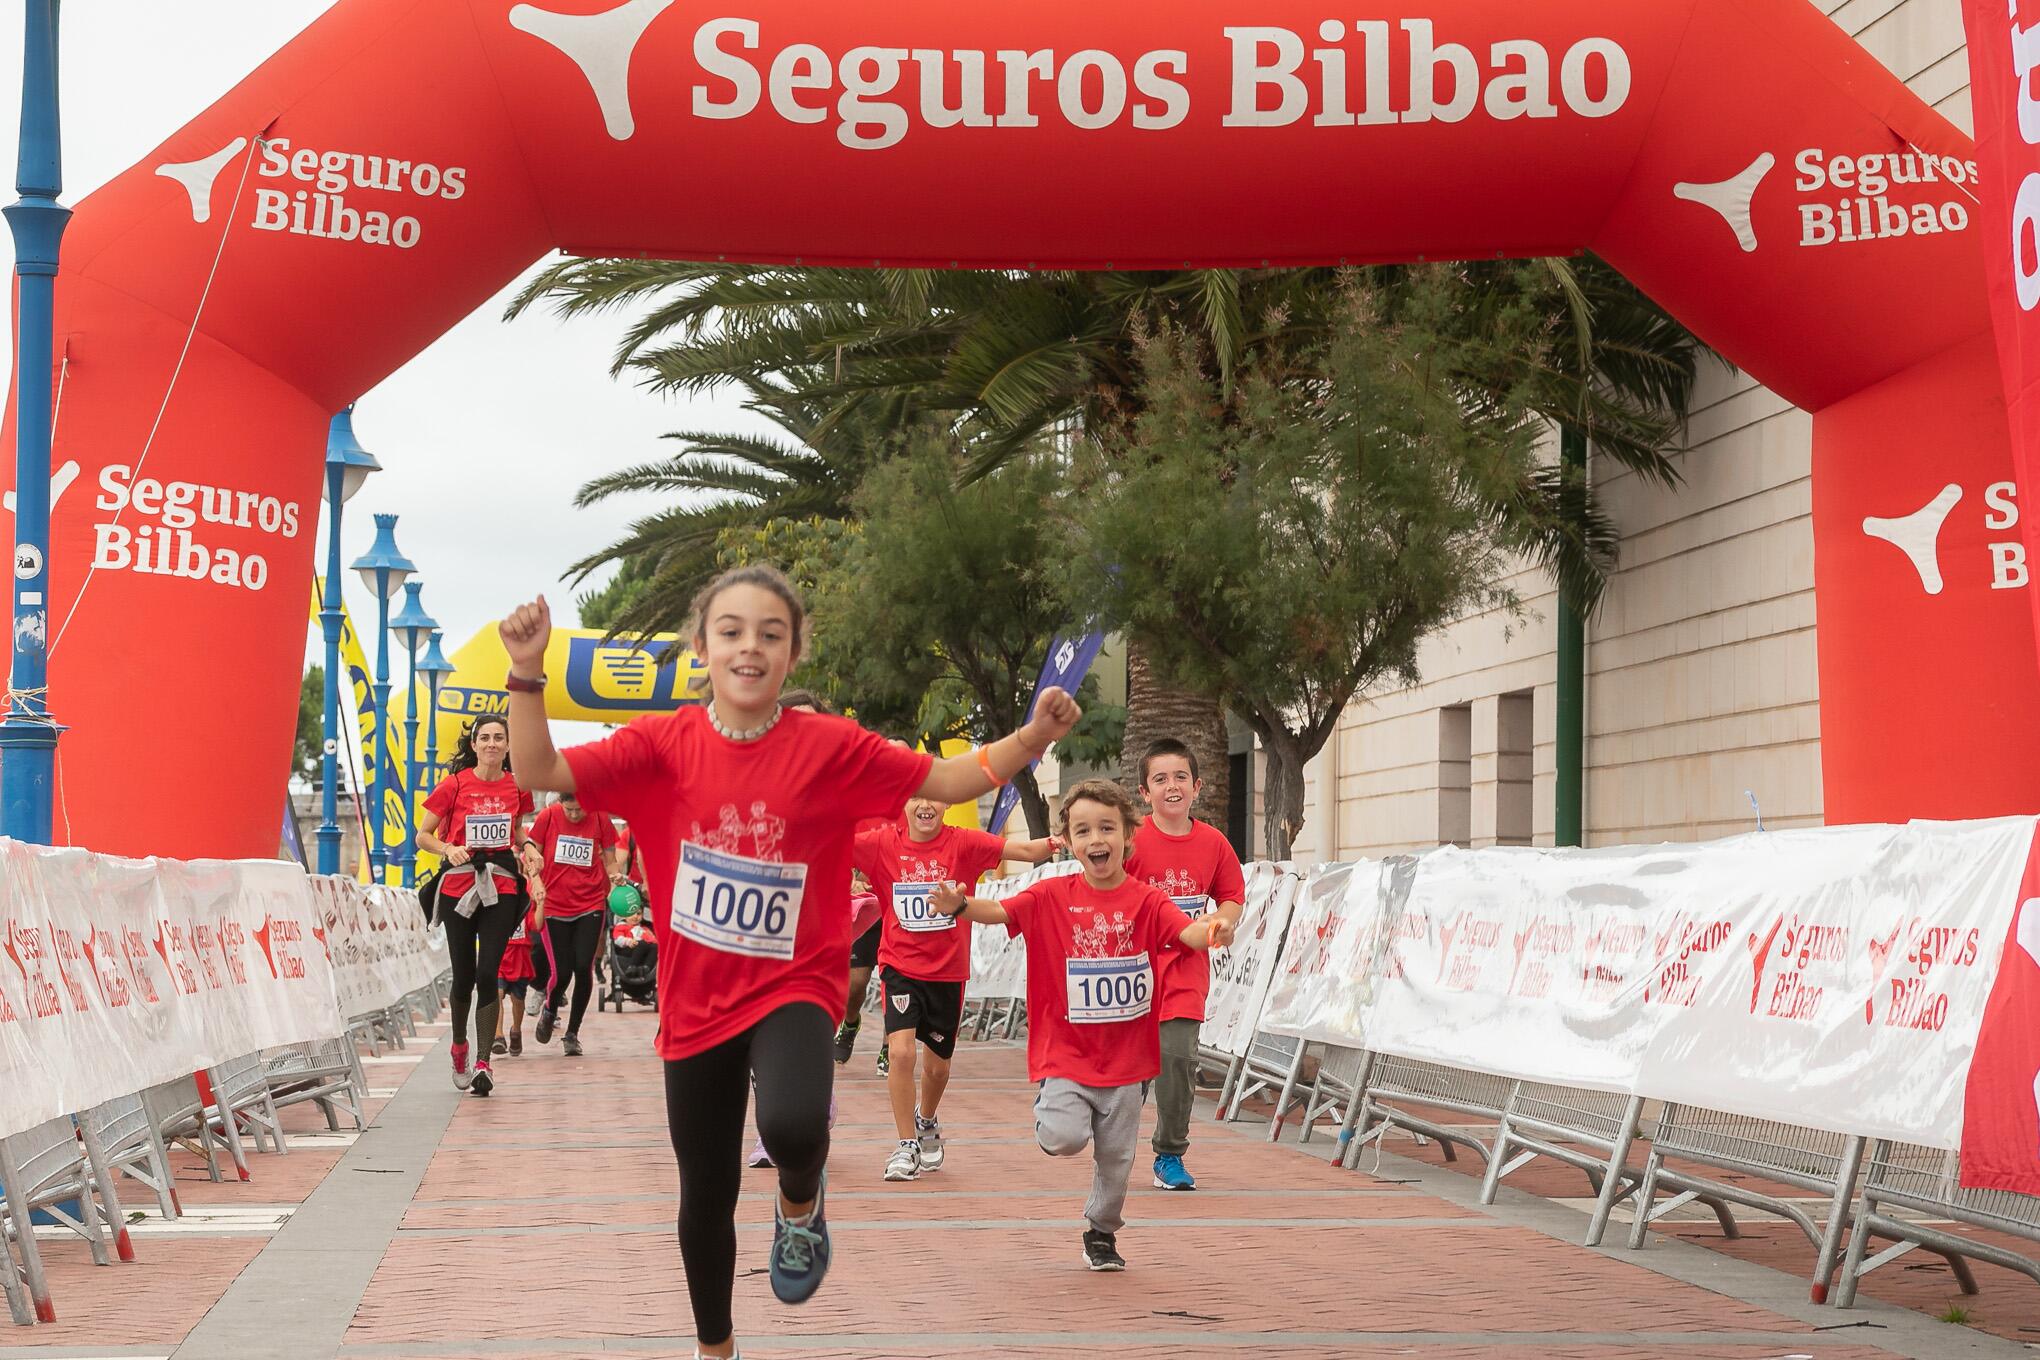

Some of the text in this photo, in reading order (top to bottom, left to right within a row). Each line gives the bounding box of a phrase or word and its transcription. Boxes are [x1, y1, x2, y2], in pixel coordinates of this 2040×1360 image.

[692, 17, 1631, 150] Seguros Bilbao
[258, 137, 466, 200] Seguros
[1794, 148, 1979, 196] Seguros
[251, 188, 421, 249] Bilbao
[1798, 196, 1969, 247] Bilbao
[96, 464, 299, 538] Seguros
[90, 523, 268, 591] Bilbao
[472, 823, 507, 840] 1006
[561, 844, 590, 860] 1005
[691, 875, 790, 935] 1006
[900, 896, 949, 919] 100
[1078, 973, 1147, 1007] 1006
[1767, 972, 1823, 1021] Bilbao
[1885, 978, 1948, 1031] Bilbao
